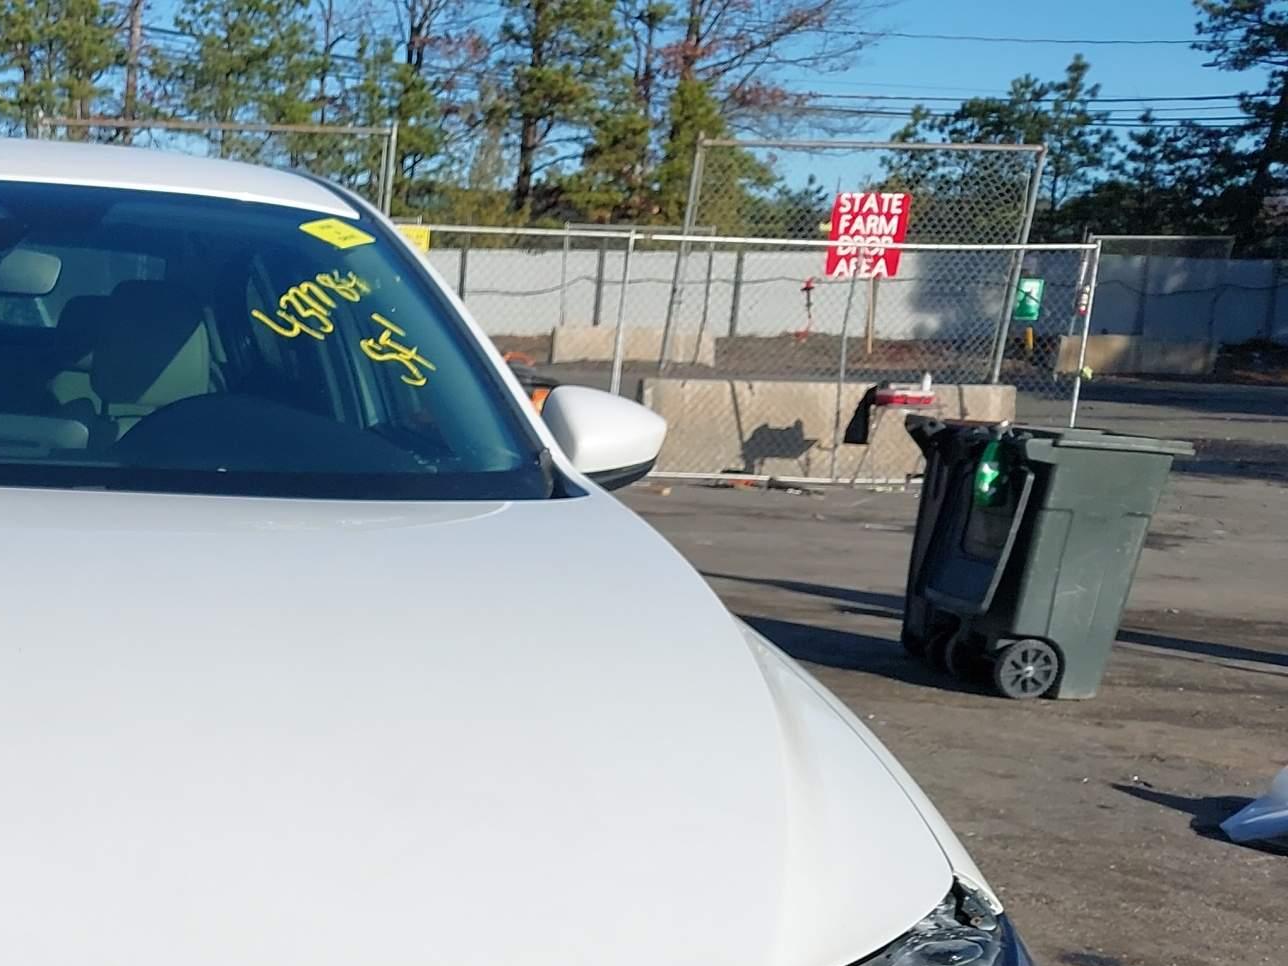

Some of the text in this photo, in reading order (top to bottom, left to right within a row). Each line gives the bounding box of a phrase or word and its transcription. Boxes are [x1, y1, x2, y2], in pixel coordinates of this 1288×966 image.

[839, 193, 905, 214] STATE
[838, 214, 899, 235] FARM
[836, 235, 894, 256] DROP
[832, 257, 889, 278] AREA
